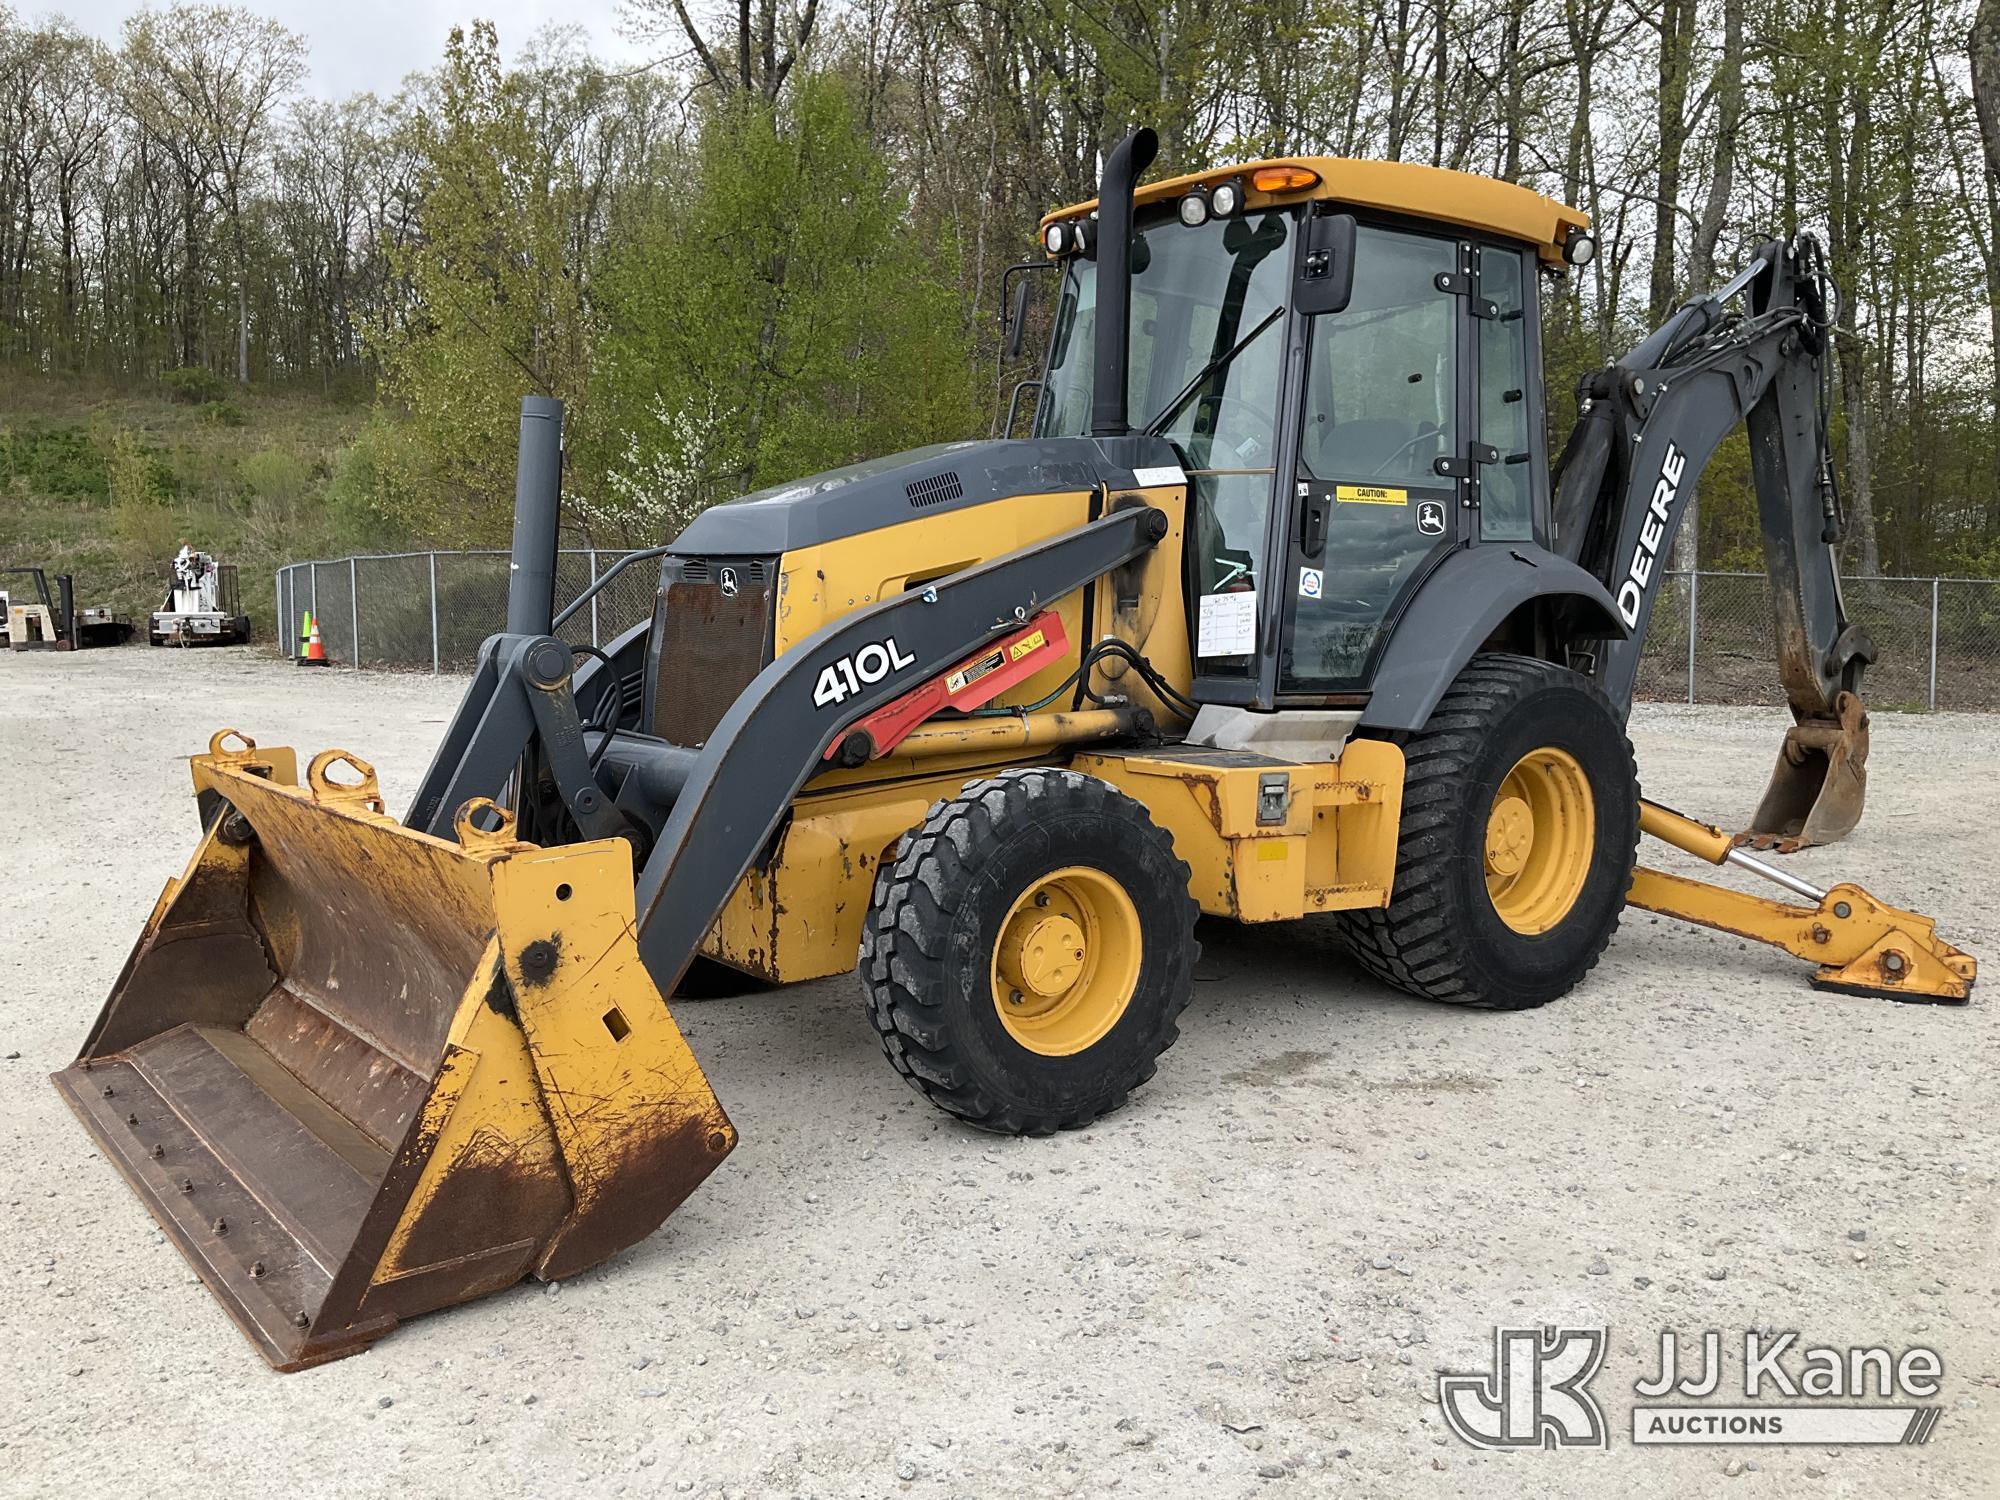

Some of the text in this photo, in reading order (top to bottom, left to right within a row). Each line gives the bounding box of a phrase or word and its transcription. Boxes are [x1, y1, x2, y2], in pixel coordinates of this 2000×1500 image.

[1357, 488, 1388, 498] CAUTION:
[1617, 443, 1686, 629] DEERE
[813, 638, 915, 708] 410L
